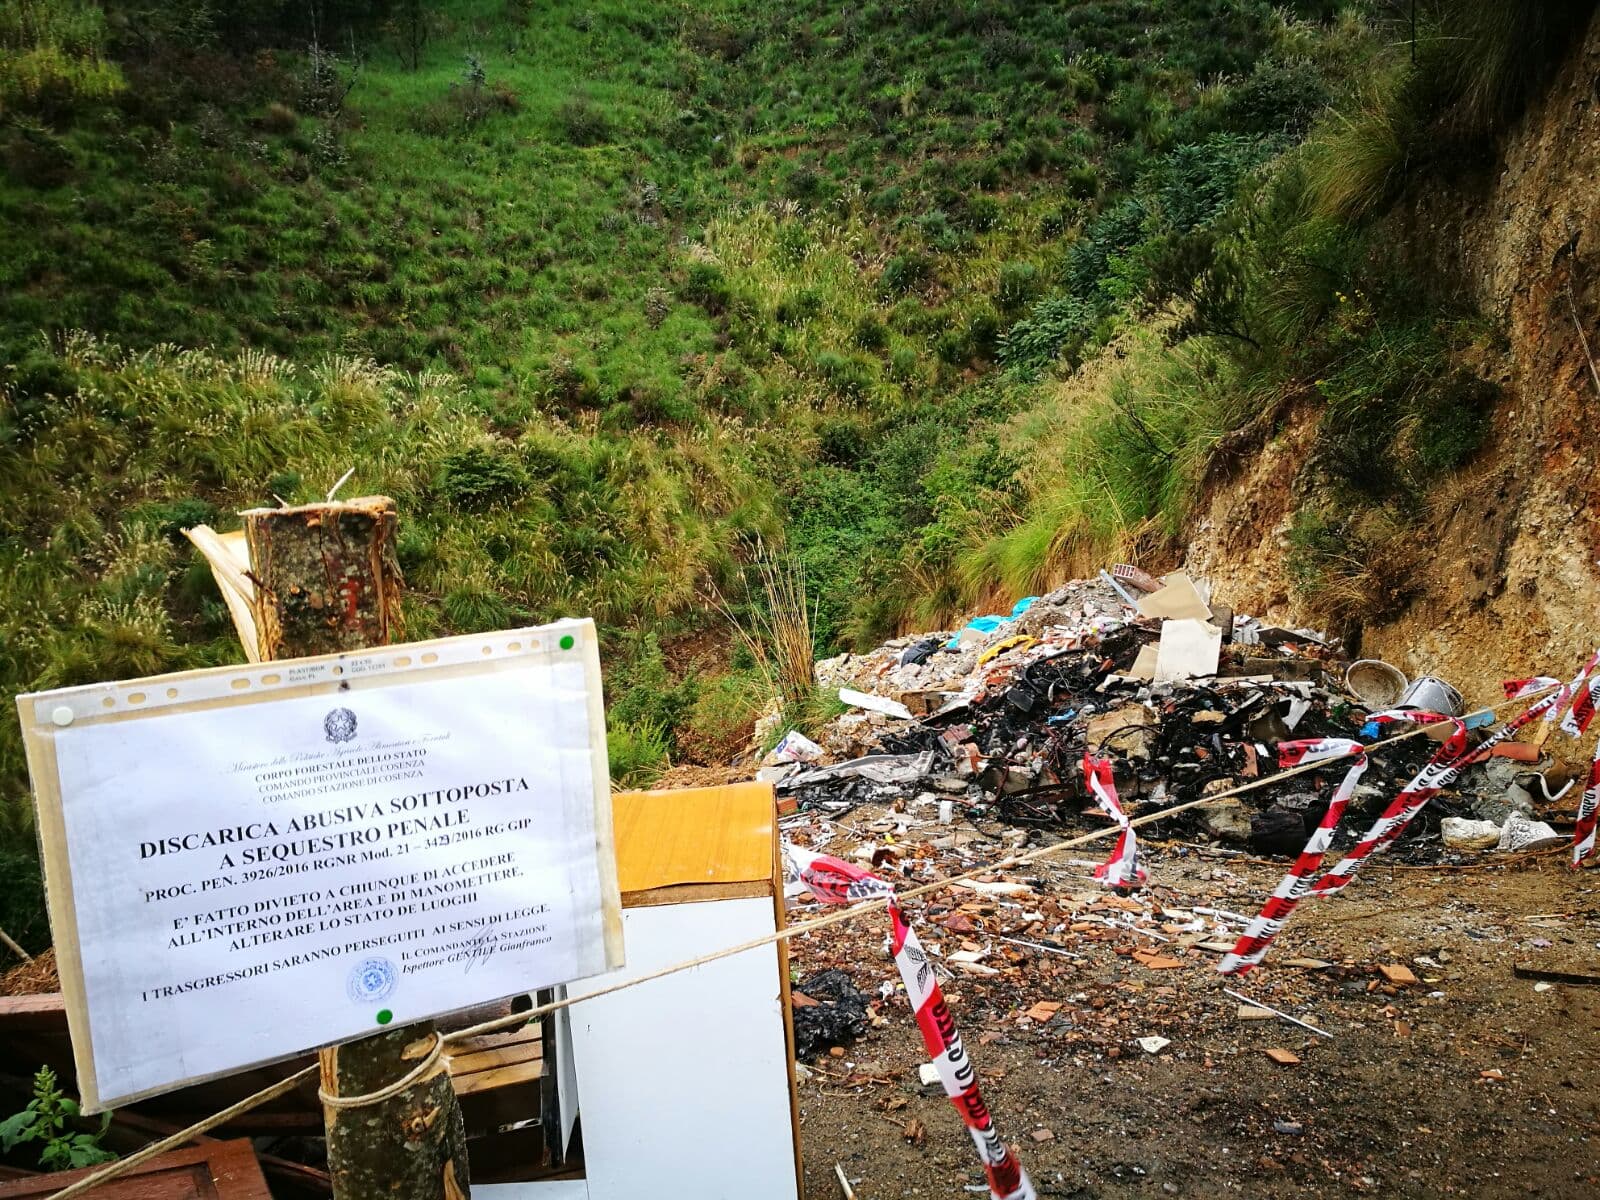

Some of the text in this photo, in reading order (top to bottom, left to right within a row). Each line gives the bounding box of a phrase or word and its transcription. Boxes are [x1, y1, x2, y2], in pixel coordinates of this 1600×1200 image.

[255, 747, 427, 783] CORPO FORESTALE DELLO STATO
[258, 759, 425, 794] COMANDO PROVINCIALE COSENZA
[262, 770, 424, 804] COMANDO STAZIONE DI COSENZA
[140, 777, 530, 859] DISCARICA ABUSIVA SOTTOPOSTA
[219, 808, 471, 870] A SEQUESTRO PENALE
[145, 883, 197, 903] PROC.
[201, 875, 238, 892] PEN.
[242, 862, 309, 884] 3926/2016
[313, 854, 357, 871] RGNR
[360, 848, 393, 863] Mod.
[397, 843, 410, 855] 21
[485, 823, 505, 836] RG
[508, 817, 532, 831] GIP
[194, 904, 250, 926] FATTO
[253, 890, 321, 913] DIVIETO
[324, 888, 336, 900] A
[339, 873, 420, 897] CHIUNQUE
[423, 869, 438, 881] DI
[442, 851, 516, 877] ACCEDERE
[377, 895, 388, 905] E
[390, 891, 406, 903] DI
[410, 866, 524, 899] MANOMETTERE.
[229, 891, 478, 952] ALTERARE LO STATO DE LUOGHI
[142, 903, 551, 1002] I TRASGRESSORI SARANNO PERSEGUITI AI SENSI DI LEGGE.
[402, 936, 552, 974] Ispettore GENTILE Gianfranco
